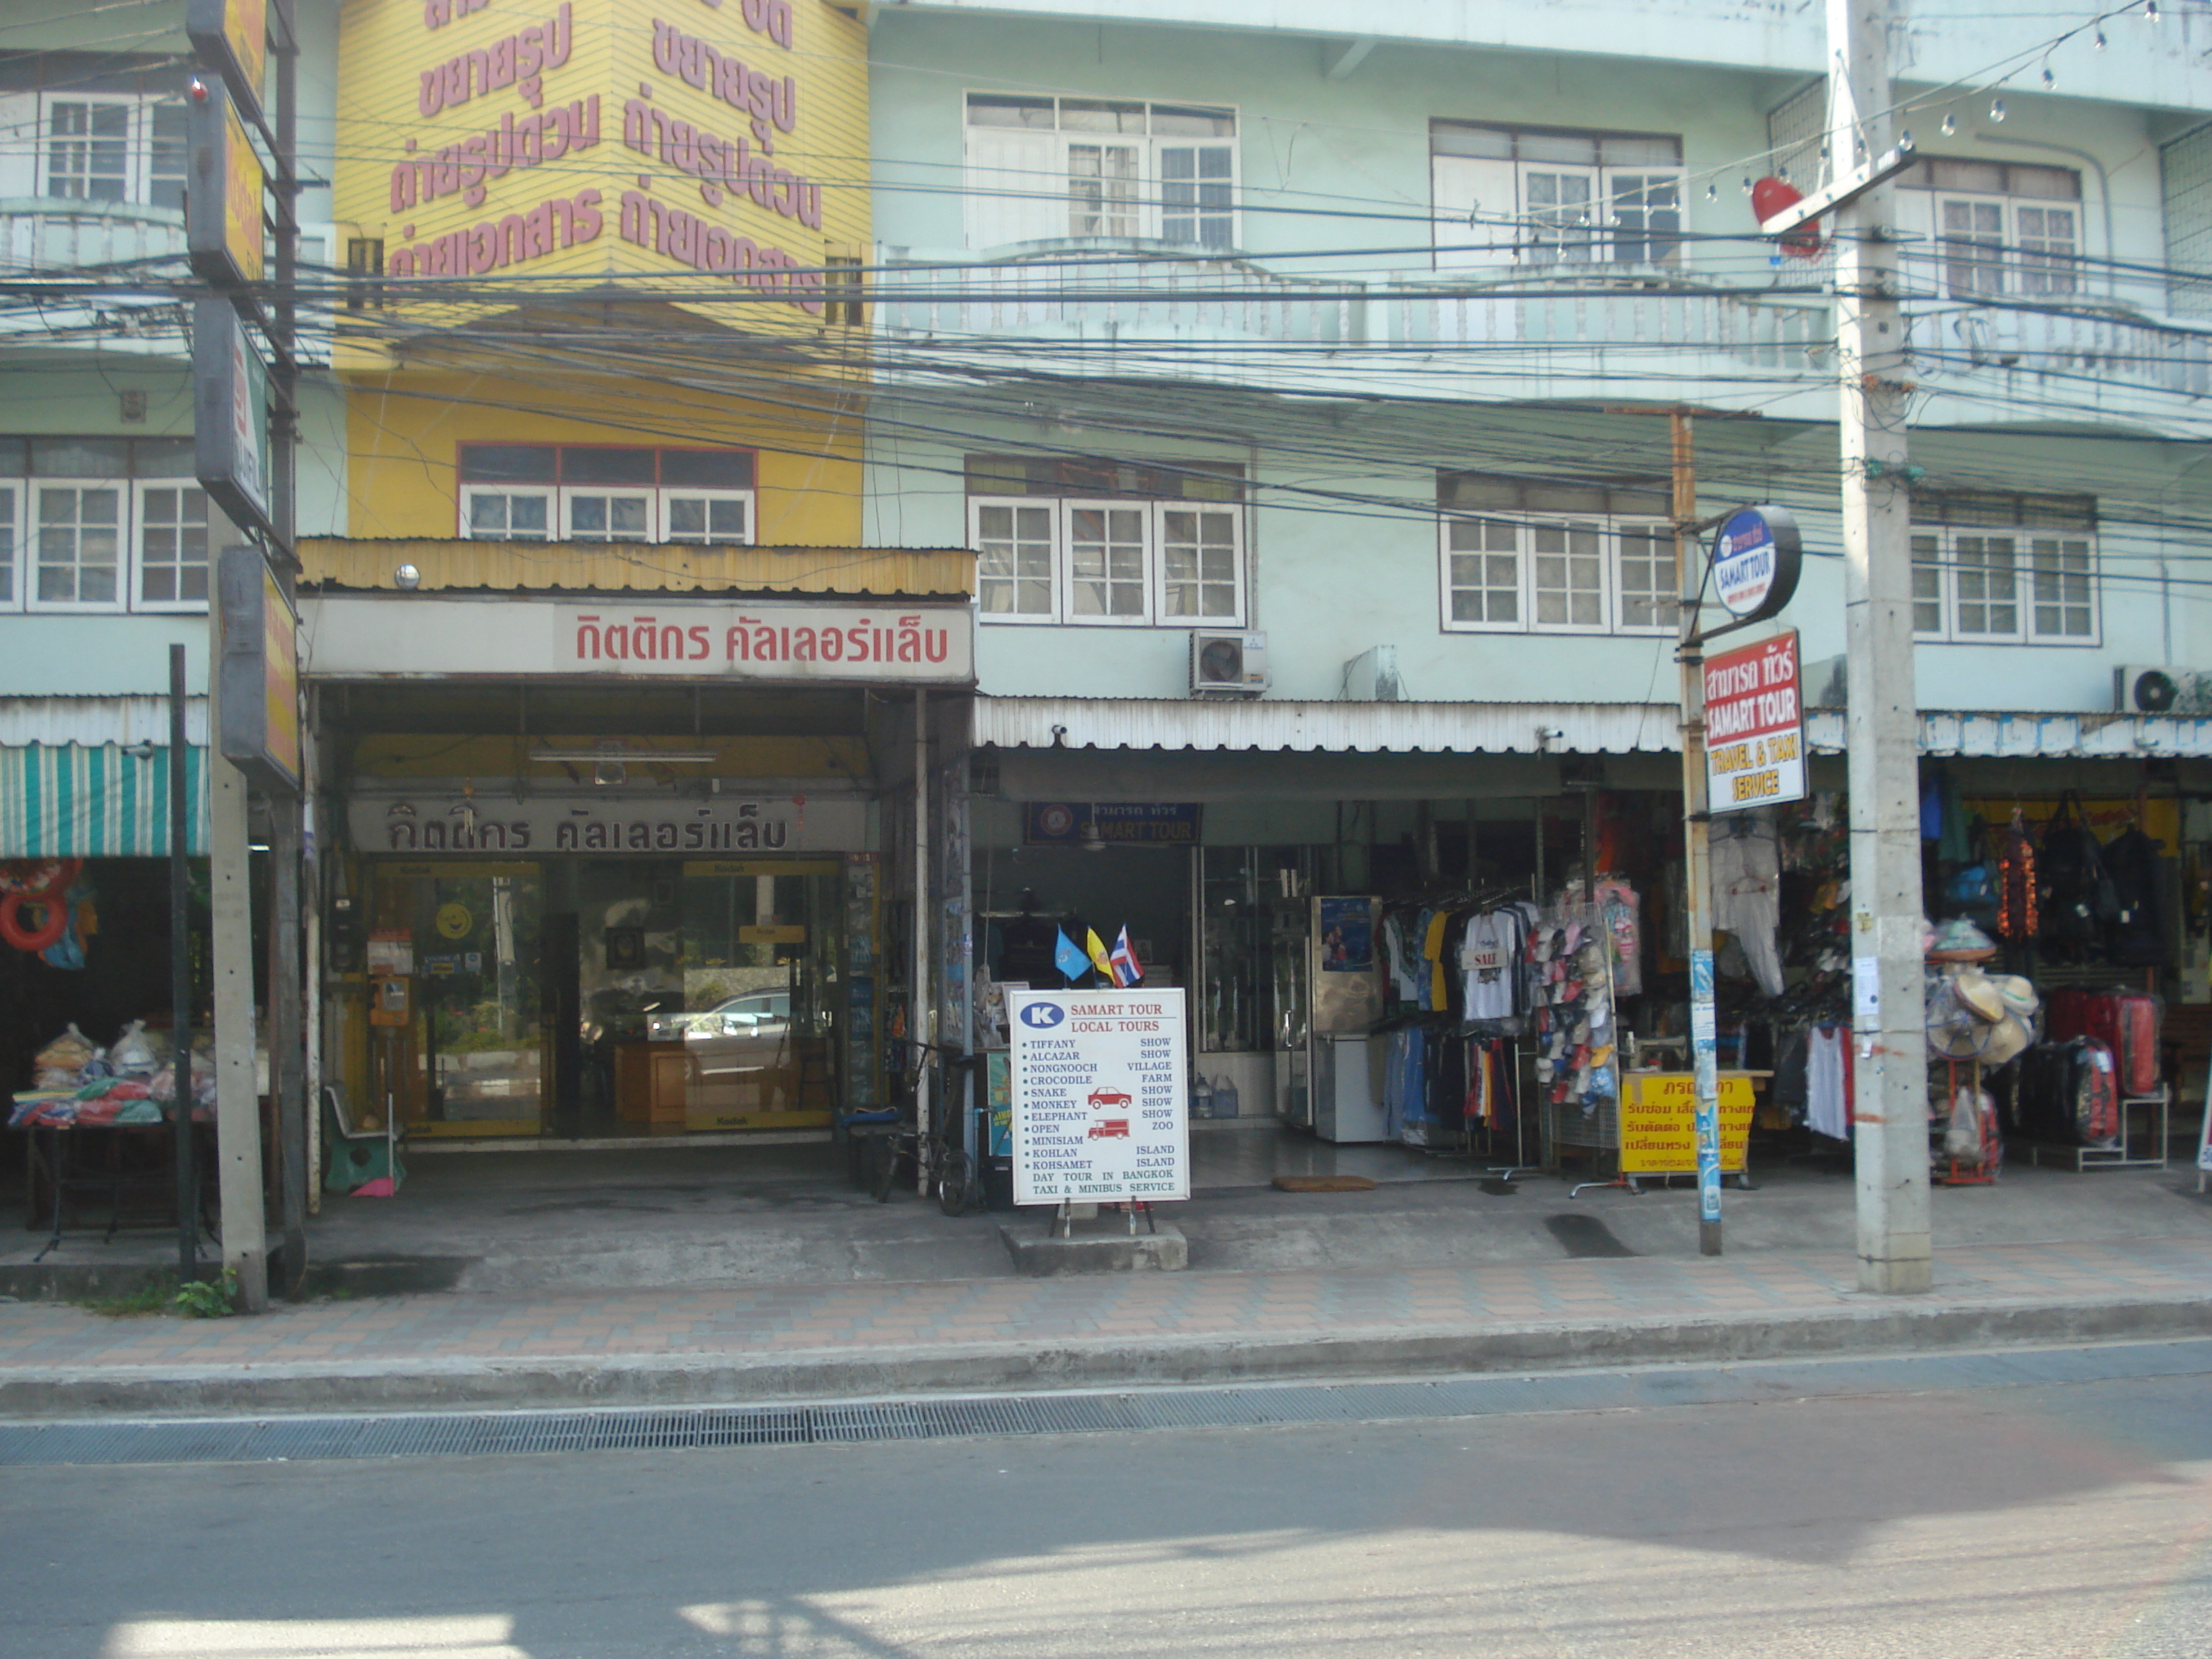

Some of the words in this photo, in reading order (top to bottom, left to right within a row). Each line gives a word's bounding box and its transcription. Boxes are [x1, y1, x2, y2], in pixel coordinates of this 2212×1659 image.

[418, 1, 572, 117] ขยายรูป
[652, 17, 796, 140] ขยายรูป
[1721, 559, 1749, 590] SAMART
[1750, 552, 1771, 580] TOUR
[577, 614, 710, 660] กิตติกร
[726, 614, 948, 663] คัลเลอร์แล็บ
[1707, 662, 1758, 702] สามารถ
[1762, 641, 1794, 687] ทัวร์
[1708, 696, 1756, 739] SAMART
[1757, 686, 1797, 726] TOUR
[1709, 743, 1753, 775] TRAVEL
[1756, 741, 1767, 765] &
[1767, 734, 1799, 765] TAXI
[1732, 769, 1780, 801] SERVICE
[555, 802, 788, 850] คัลเลอร์แล็บ
[1080, 821, 1146, 840] SMART
[1149, 821, 1192, 840] TOUR
[1031, 1007, 1054, 1024] K
[1071, 1004, 1124, 1015] SAMART
[1128, 1004, 1163, 1015] TOUR
[1071, 1021, 1112, 1033] LOCAL
[1118, 1021, 1159, 1032] TOURS
[1030, 1040, 1076, 1048] TIFFANY
[1141, 1038, 1172, 1047] SHOW
[1030, 1052, 1080, 1061] ALCAZAR
[1141, 1050, 1172, 1059] SHOW
[1030, 1064, 1098, 1073] NONGNOOCH
[1127, 1061, 1172, 1071] VILLAGE
[1030, 1076, 1093, 1084] CROCODILE
[1142, 1074, 1173, 1082] FARM
[1031, 1088, 1067, 1097] SNAKE
[1141, 1086, 1173, 1094] SHOW
[1031, 1100, 1077, 1110] MONKEY
[1142, 1097, 1173, 1107] SHOW
[716, 1116, 748, 1125] Kodak
[1032, 1112, 1087, 1121] ELEPHANT
[1142, 1109, 1173, 1118] SHOW
[1032, 1124, 1060, 1133] OPEN
[1151, 1122, 1174, 1130] ZOO
[1032, 1136, 1084, 1145] MINISIAM
[1033, 1148, 1077, 1157] KOHLAN
[1136, 1146, 1174, 1154] ISLAND
[1033, 1160, 1093, 1169] KOHSAMET
[1137, 1157, 1174, 1166] ISLAND
[1033, 1173, 1054, 1182] DAY
[1064, 1172, 1093, 1181] TOUR
[1102, 1172, 1113, 1180] IN
[1123, 1169, 1174, 1179] BANGKOK
[1033, 1184, 1058, 1194] TAXI
[1064, 1184, 1071, 1193] &
[1079, 1183, 1122, 1193] MINIBUS
[1130, 1182, 1175, 1192] SERVICE
